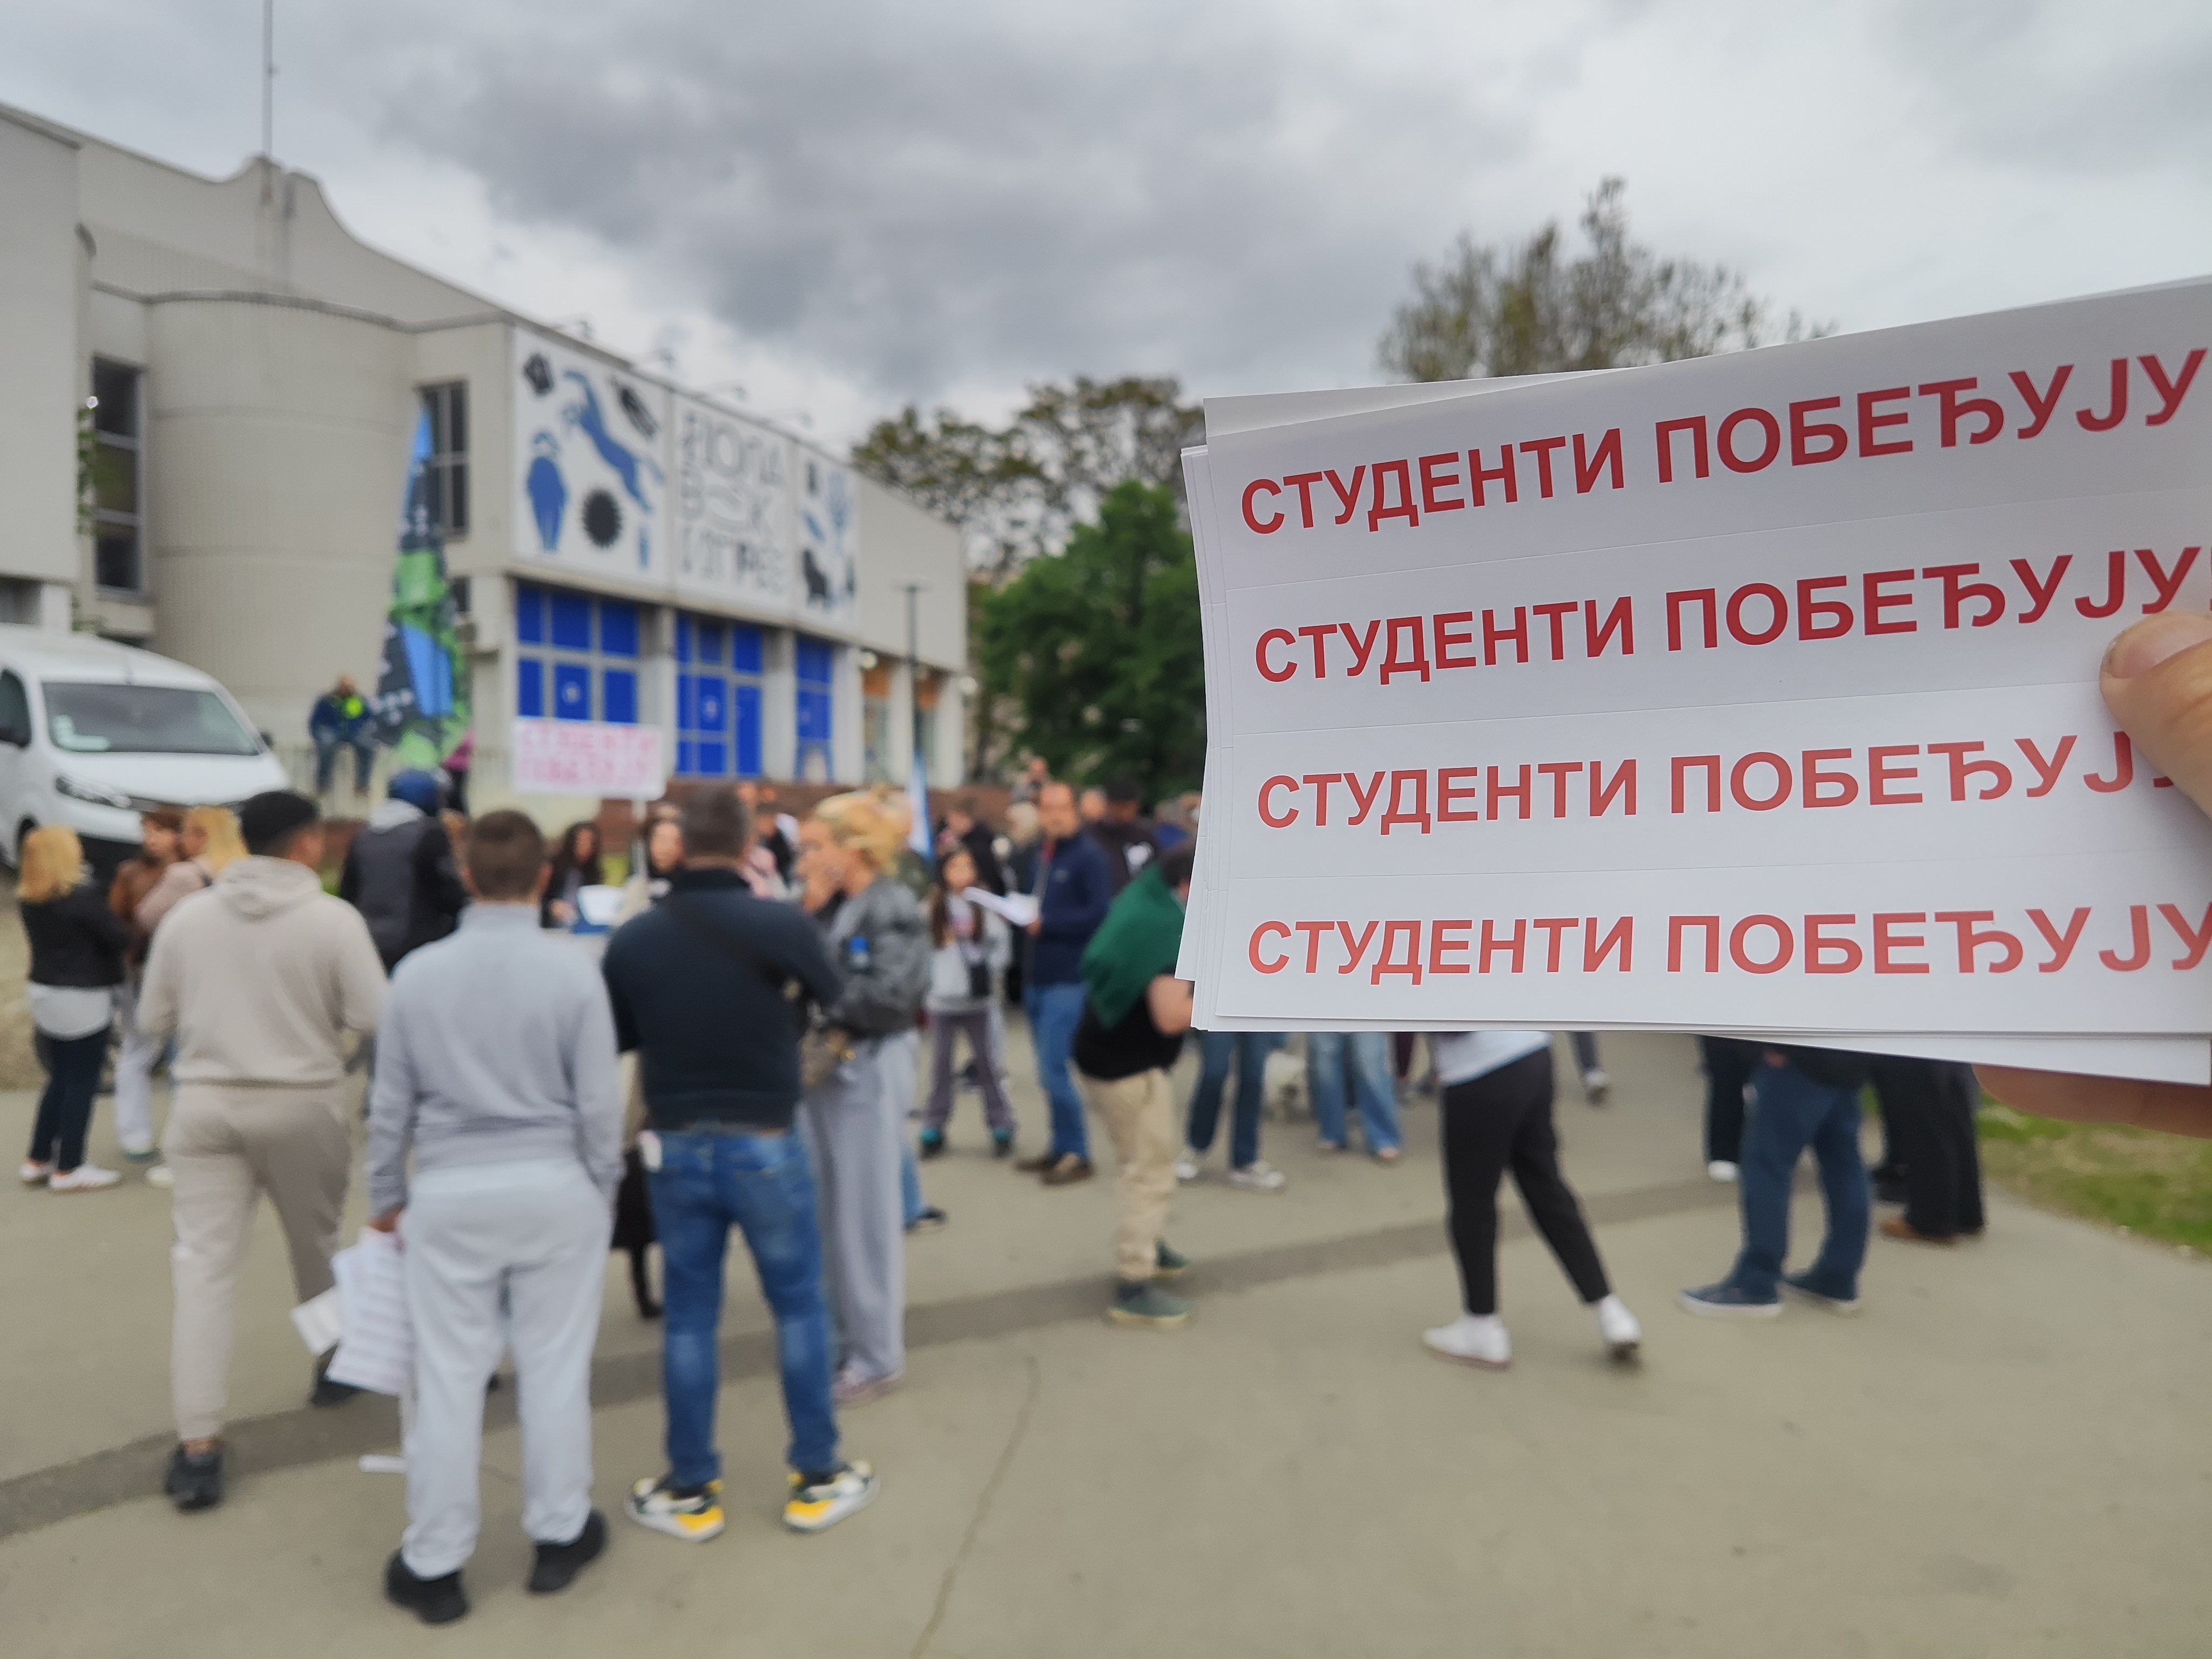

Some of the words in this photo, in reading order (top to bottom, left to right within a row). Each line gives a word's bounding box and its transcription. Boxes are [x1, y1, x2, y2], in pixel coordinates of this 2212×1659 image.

[1242, 428, 1625, 535] СТУДЕНТИ
[1656, 349, 2207, 484] ПОБЕЂУЈУ
[1256, 596, 1635, 686] СТУДЕНТИ
[1666, 546, 2212, 652] ПОБЕЂУЈУ
[1258, 759, 1637, 837] СТУДЕНТИ
[1671, 731, 2174, 815] ПОБЕЂУЈ
[1249, 916, 1634, 986] СТУДЕНТИ
[1668, 902, 2212, 975] ПОБЕЂУЈУ
